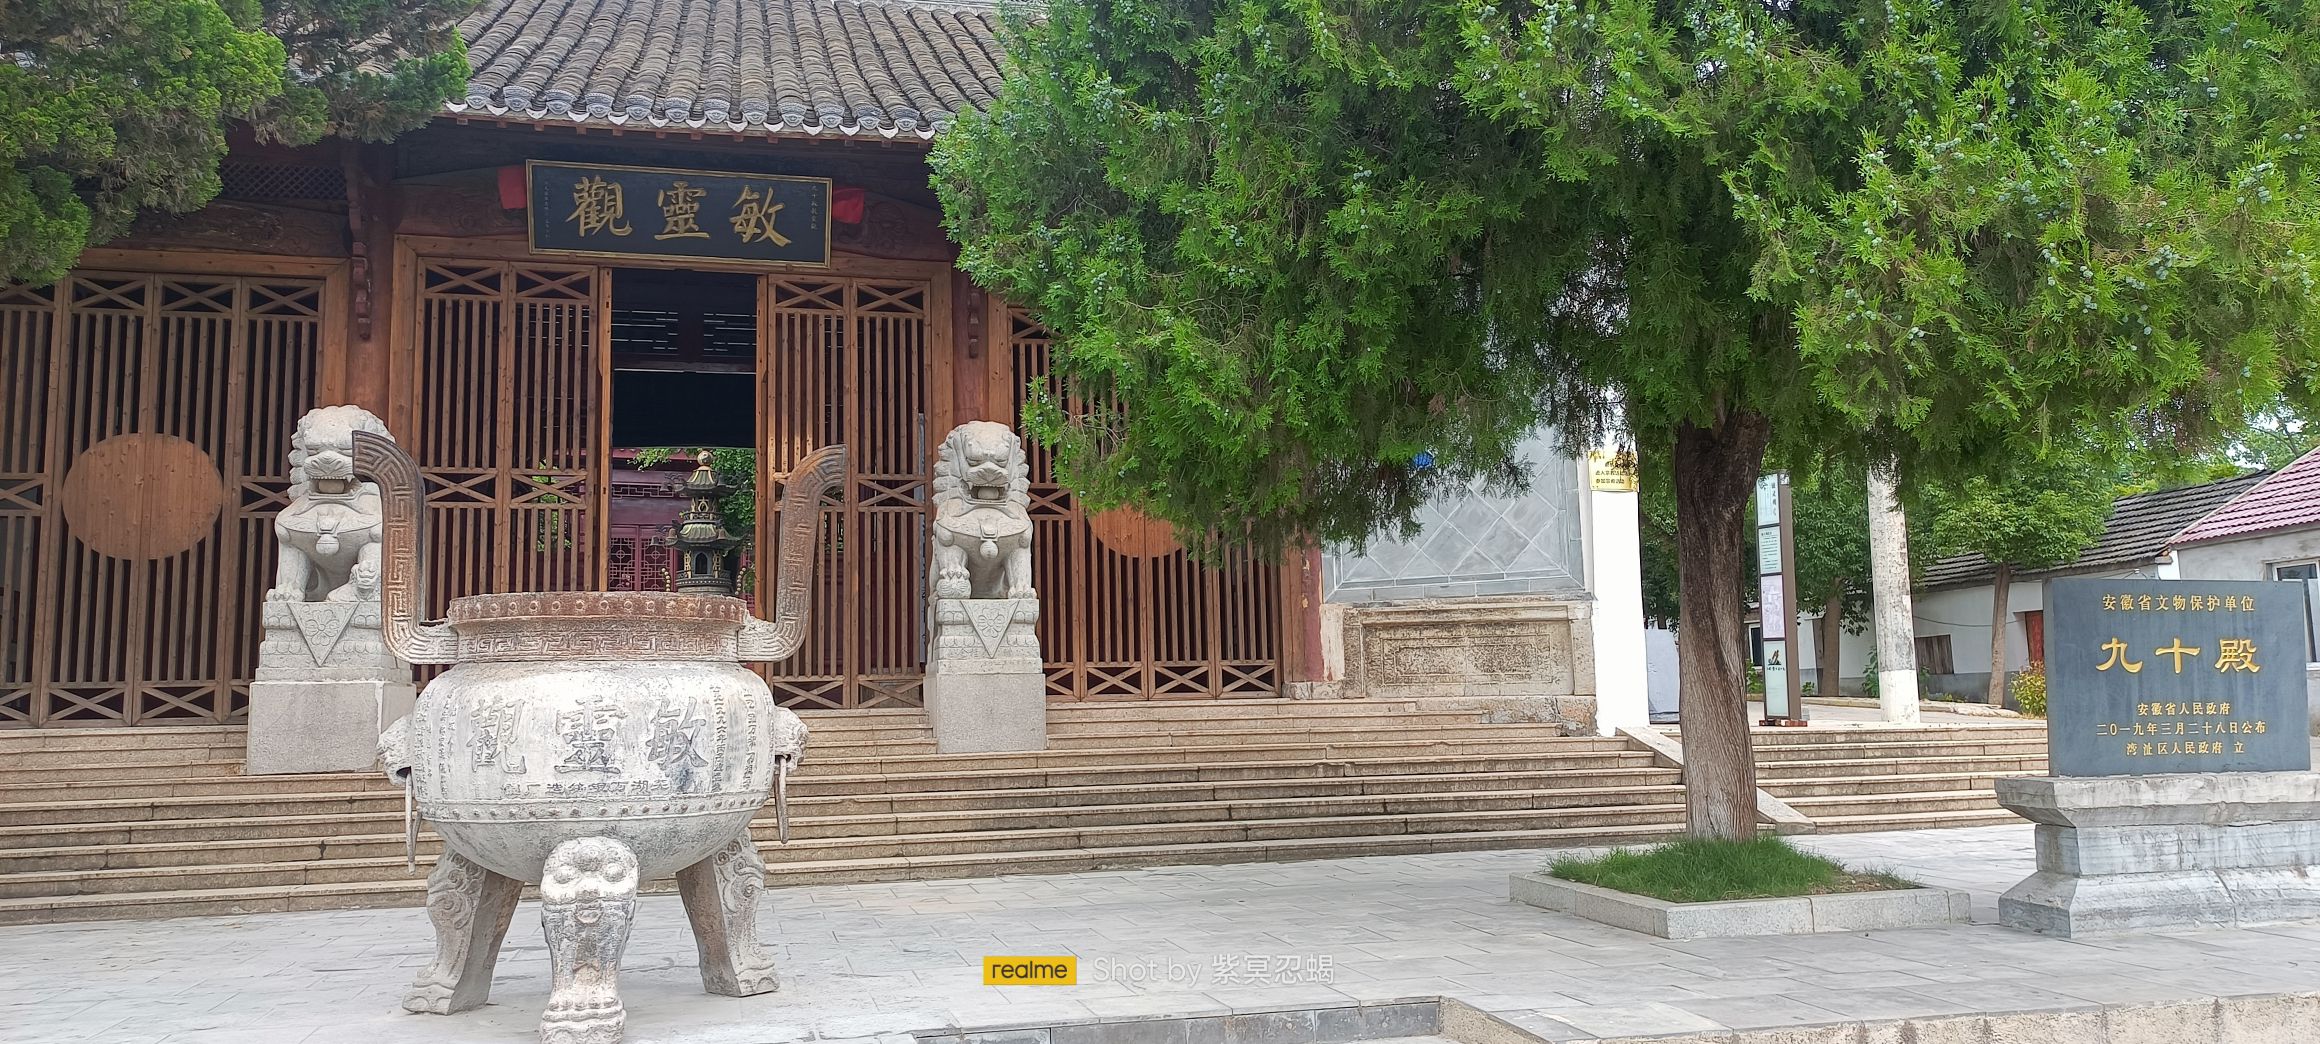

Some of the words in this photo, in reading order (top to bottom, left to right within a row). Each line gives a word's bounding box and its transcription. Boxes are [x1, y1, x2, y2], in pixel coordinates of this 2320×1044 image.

[2102, 594, 2255, 611] 安徽省文物保护单位
[2095, 637, 2261, 674] 九十殿
[2137, 702, 2232, 716] 安徽省人民政府
[2233, 741, 2246, 754] 立
